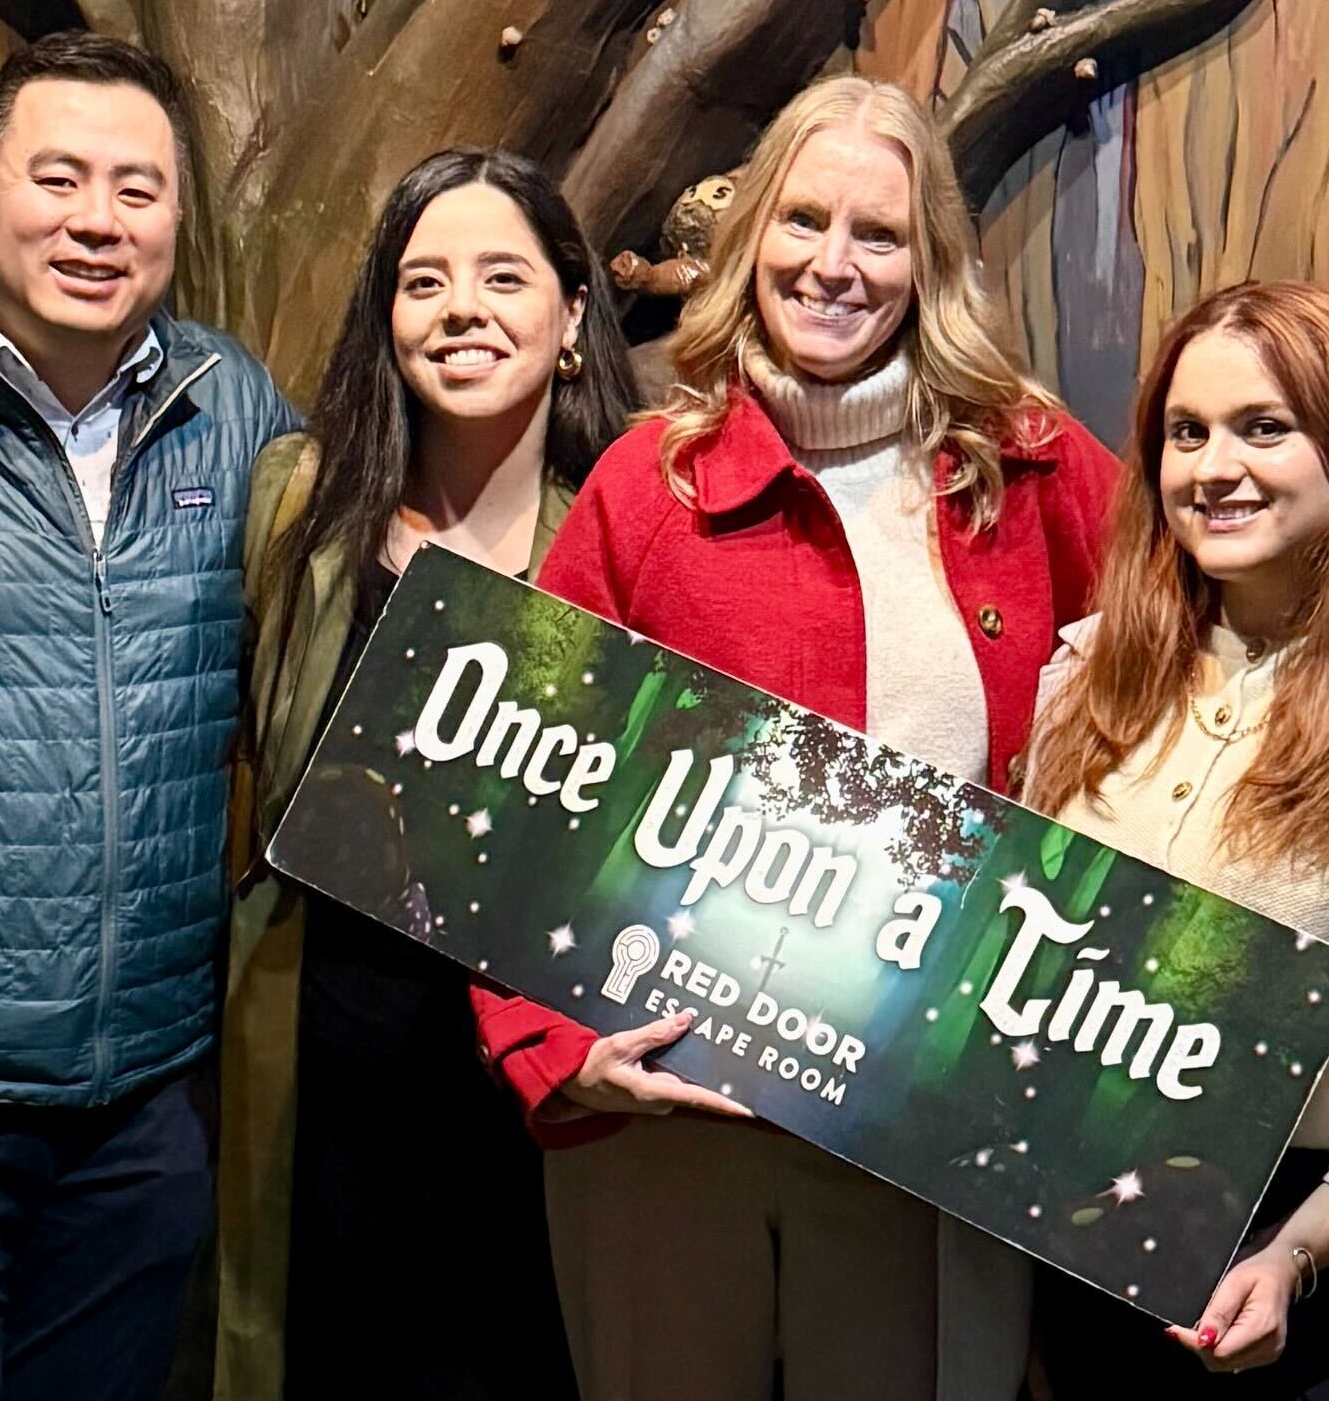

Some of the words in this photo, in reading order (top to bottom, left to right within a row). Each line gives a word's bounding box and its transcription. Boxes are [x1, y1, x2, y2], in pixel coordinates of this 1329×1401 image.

[415, 642, 616, 812] Once
[634, 749, 858, 928] Upon
[876, 892, 942, 970] a
[980, 887, 1220, 1099] Time
[660, 949, 741, 1007] RED
[746, 992, 866, 1074] DOOR
[757, 1046, 847, 1106] ROOM
